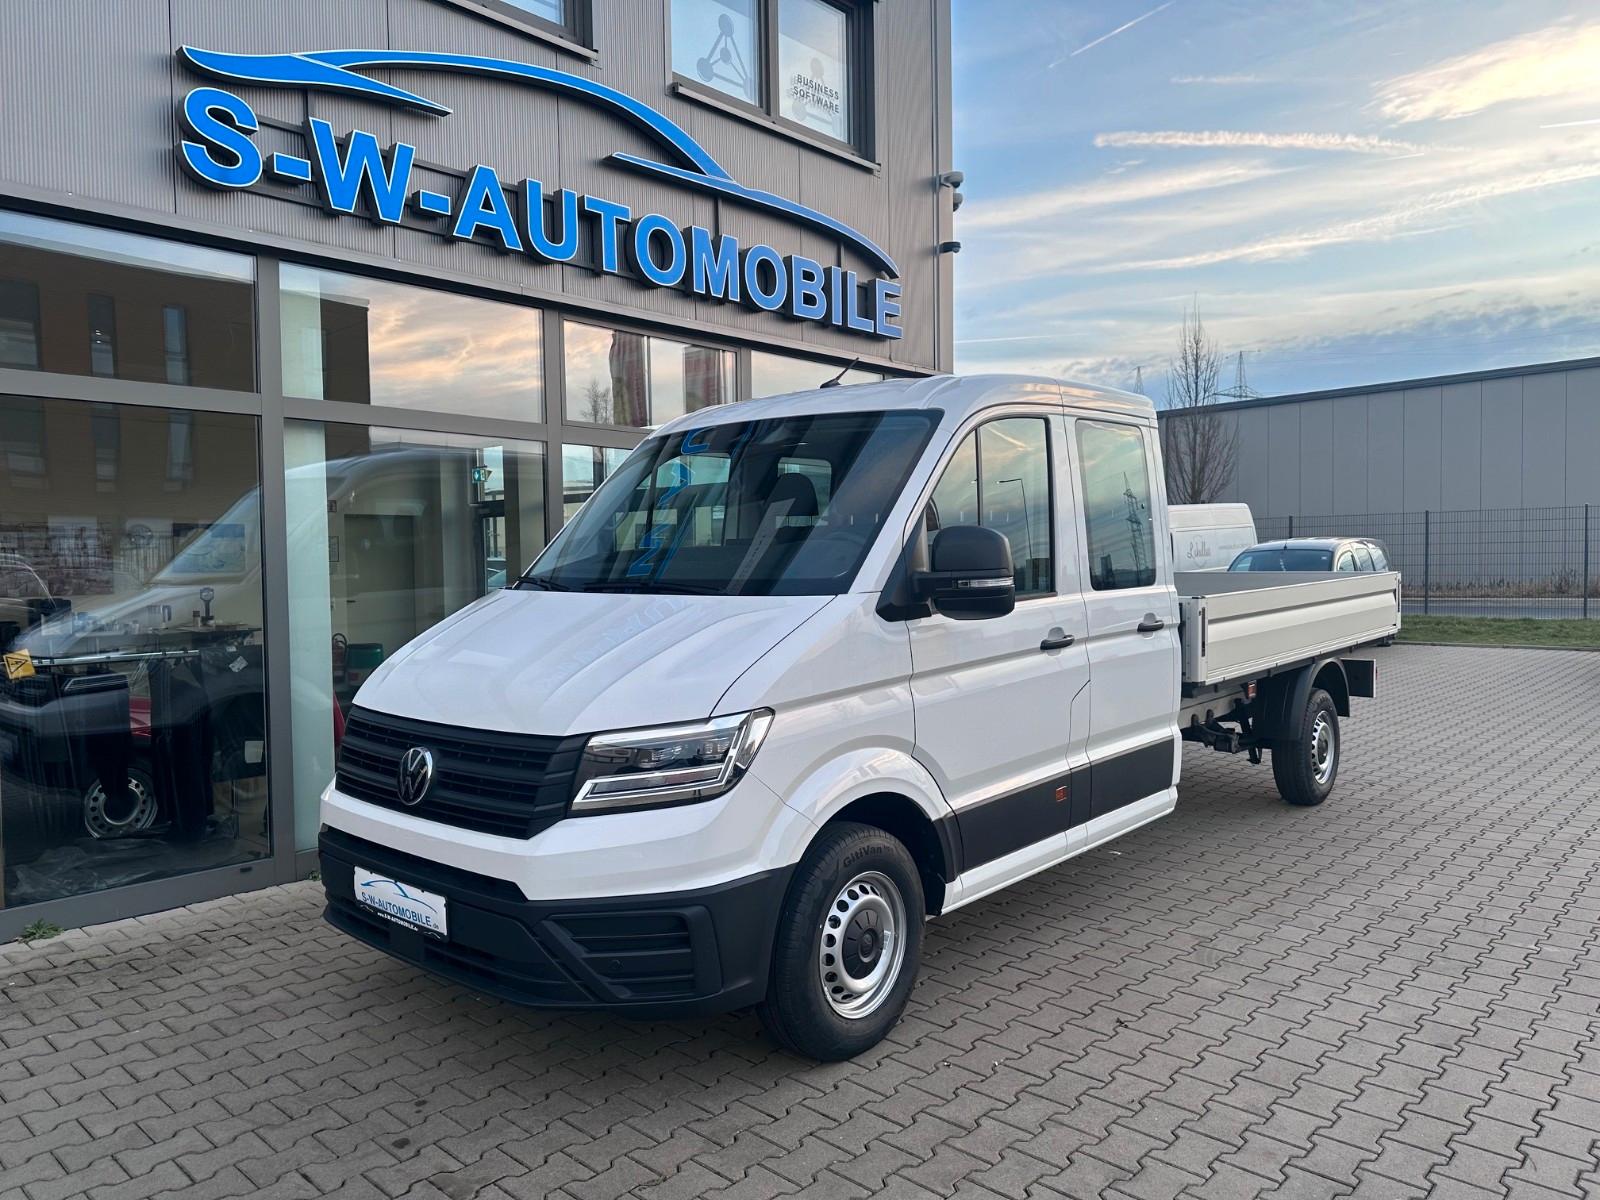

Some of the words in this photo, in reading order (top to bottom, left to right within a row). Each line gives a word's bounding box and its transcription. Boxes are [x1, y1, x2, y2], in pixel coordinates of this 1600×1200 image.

[793, 86, 840, 114] SOFTWARE
[797, 74, 839, 100] BUSINESS
[180, 87, 903, 339] S-W-AUTOMOBILE
